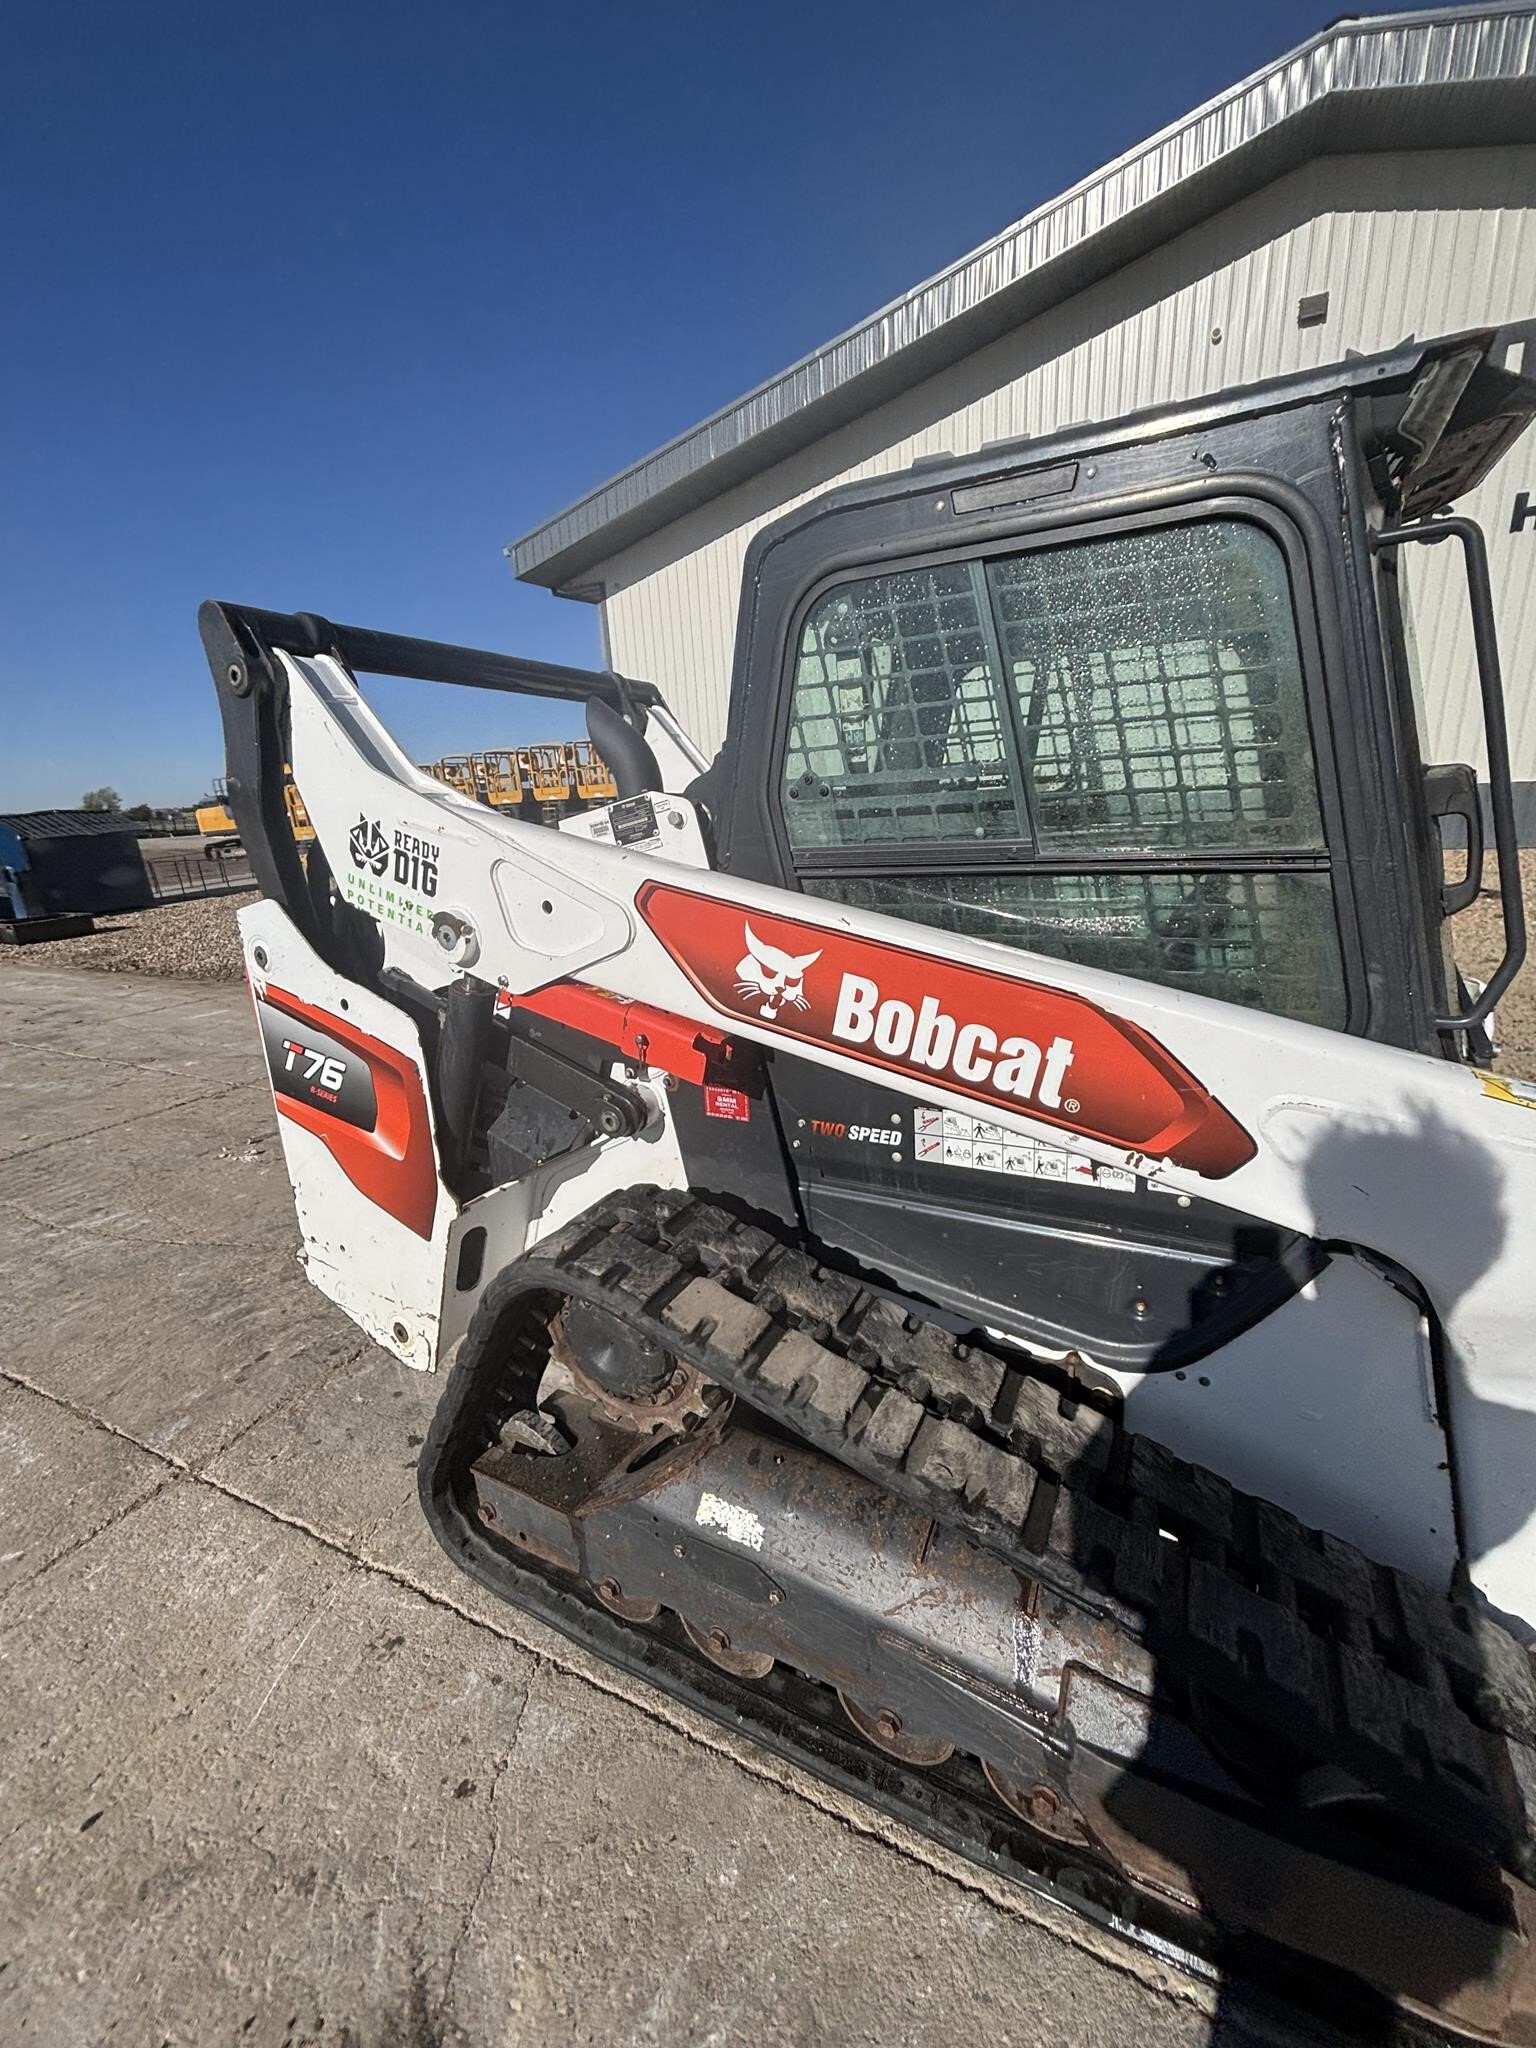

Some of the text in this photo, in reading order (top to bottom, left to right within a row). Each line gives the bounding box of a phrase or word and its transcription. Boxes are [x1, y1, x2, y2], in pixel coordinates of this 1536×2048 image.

[394, 829, 440, 863] READY
[393, 848, 438, 898] DIG
[282, 1040, 347, 1091] T76
[832, 972, 1075, 1109] Bobcat
[811, 1119, 902, 1146] TWO SPEED
